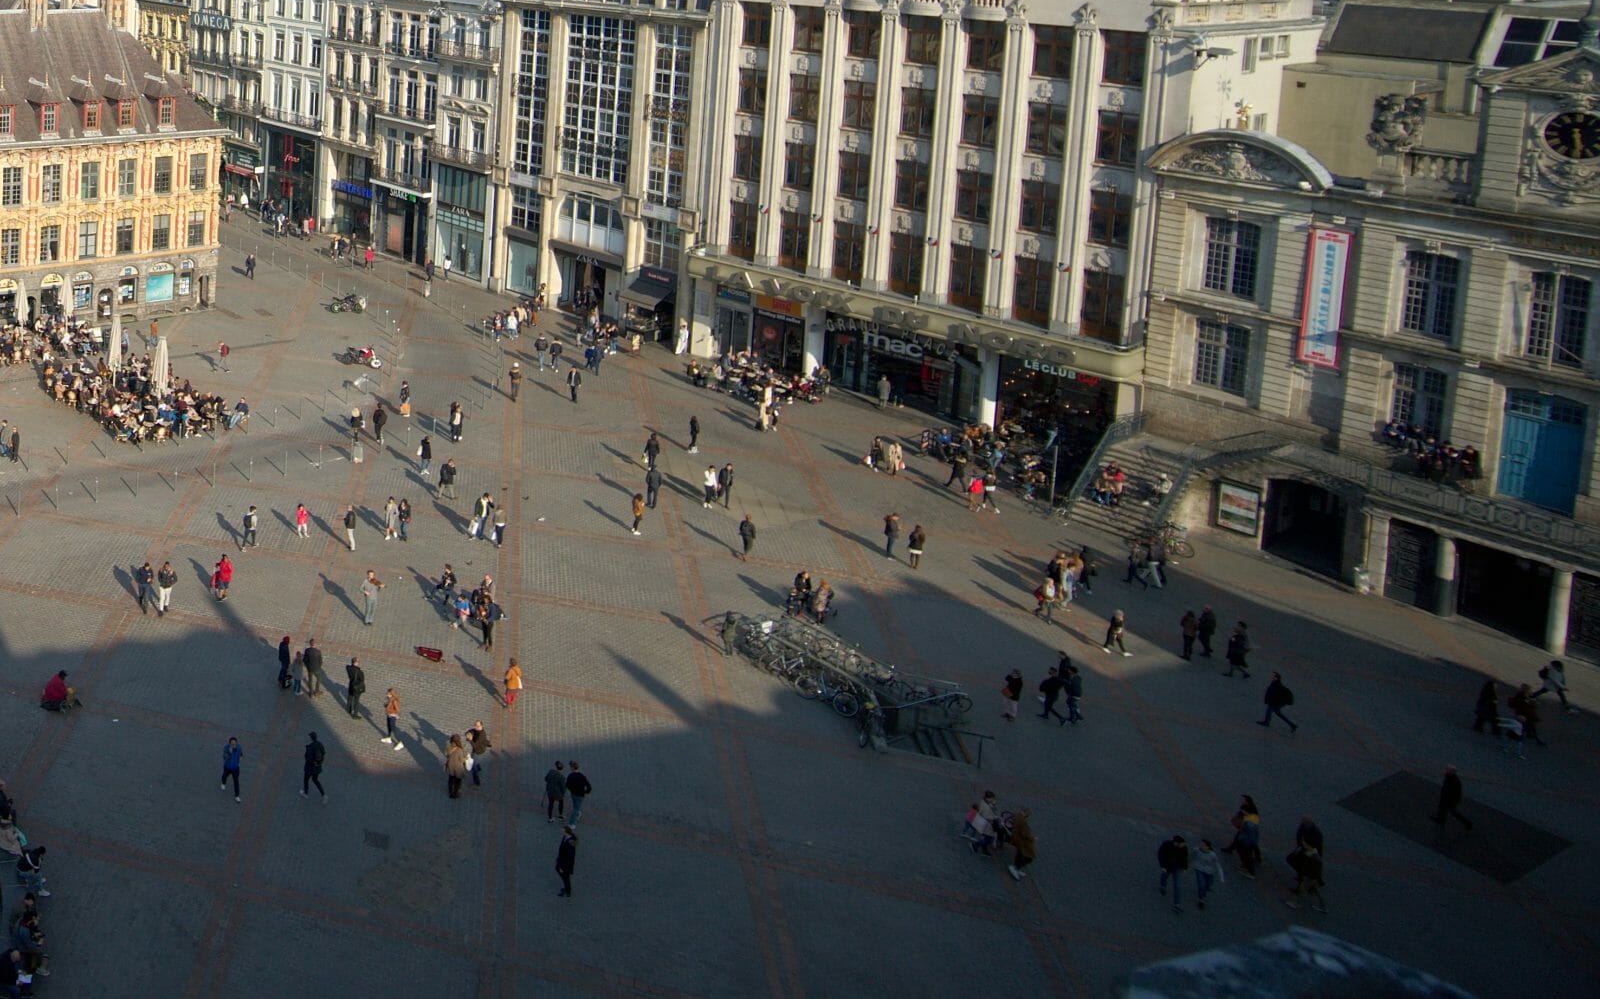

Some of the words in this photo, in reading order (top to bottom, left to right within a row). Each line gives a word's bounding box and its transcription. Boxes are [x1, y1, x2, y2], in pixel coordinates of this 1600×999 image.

[194, 14, 230, 30] OMEGA
[451, 206, 470, 217] ZARA
[576, 253, 599, 265] ZARA
[1324, 244, 1337, 276] NORD
[1321, 279, 1331, 295] DU
[702, 265, 754, 289] LA
[760, 277, 855, 314] VOIX
[873, 305, 929, 329] DU
[948, 323, 1077, 364] NORD
[827, 318, 880, 333] GRAND
[902, 328, 959, 363] PLACE
[863, 331, 923, 358] fnac
